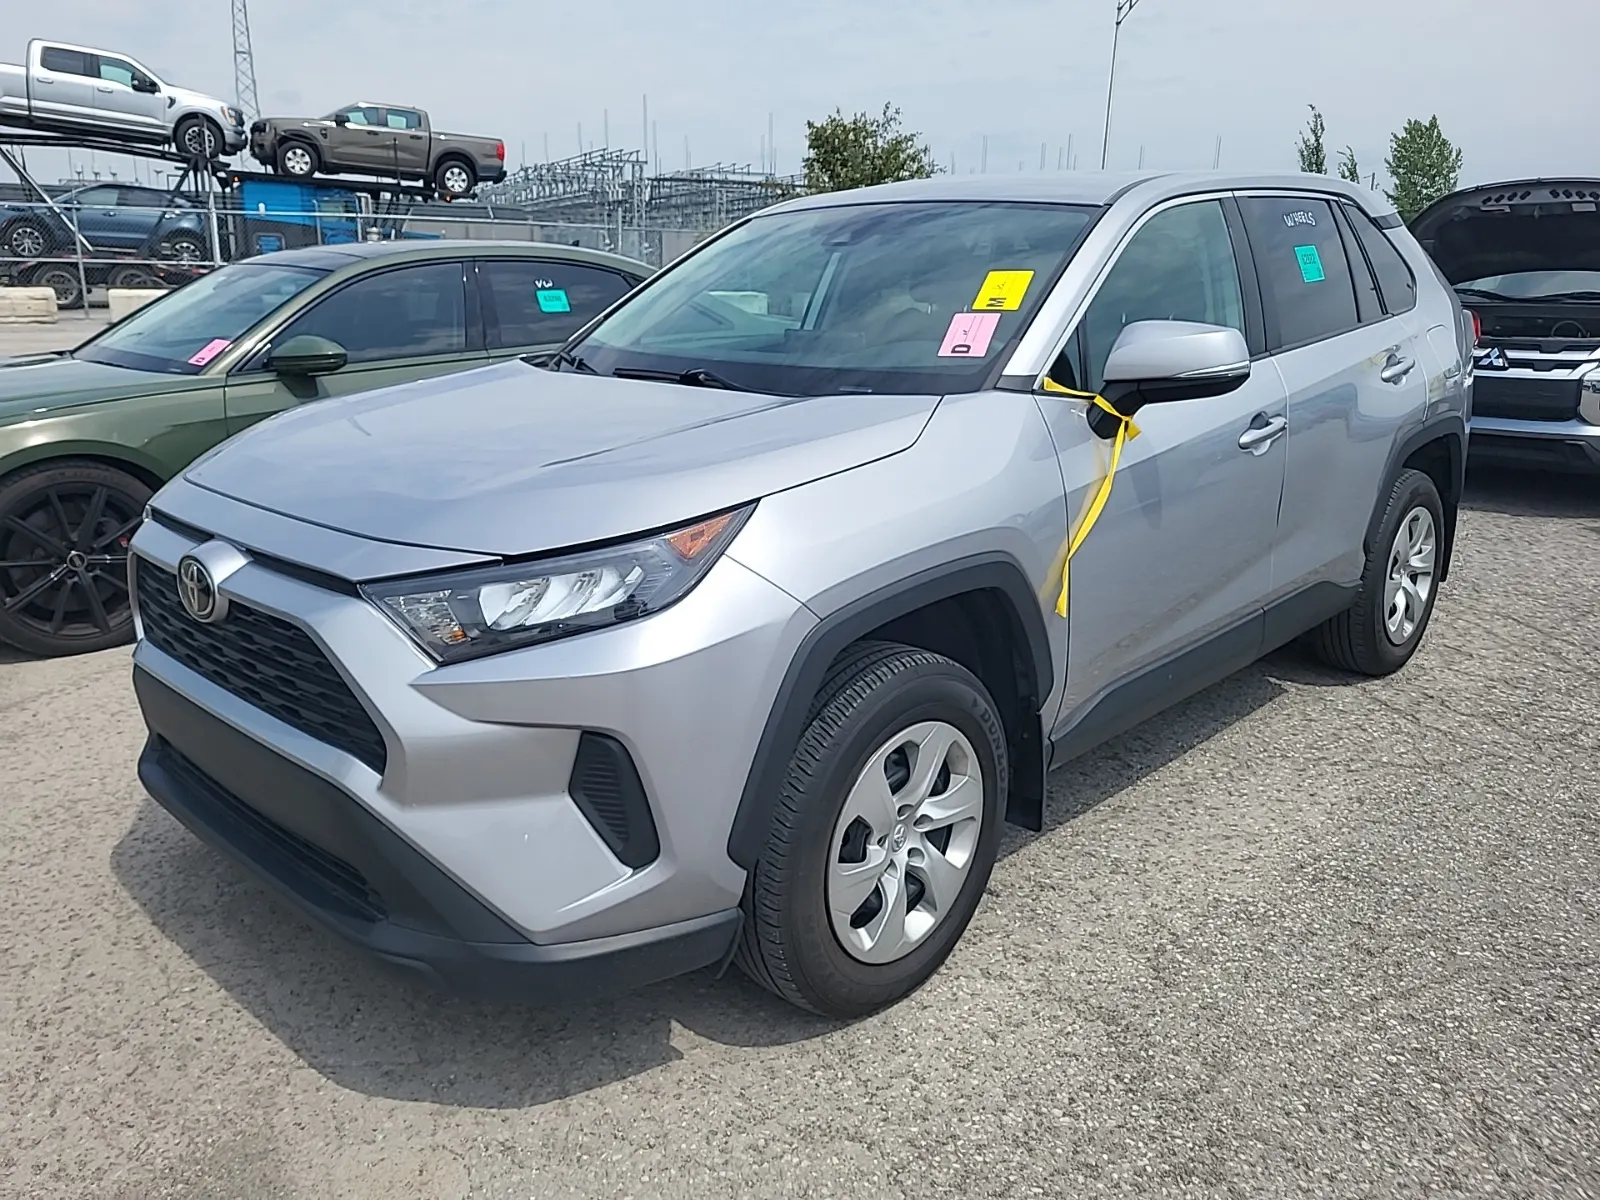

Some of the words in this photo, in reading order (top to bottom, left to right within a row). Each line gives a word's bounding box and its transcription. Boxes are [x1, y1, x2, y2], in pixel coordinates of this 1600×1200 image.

[1283, 211, 1316, 227] WHEELS
[534, 279, 553, 289] VW
[985, 297, 1007, 307] M
[950, 343, 972, 354] D
[980, 707, 1007, 802] DUNLOP
